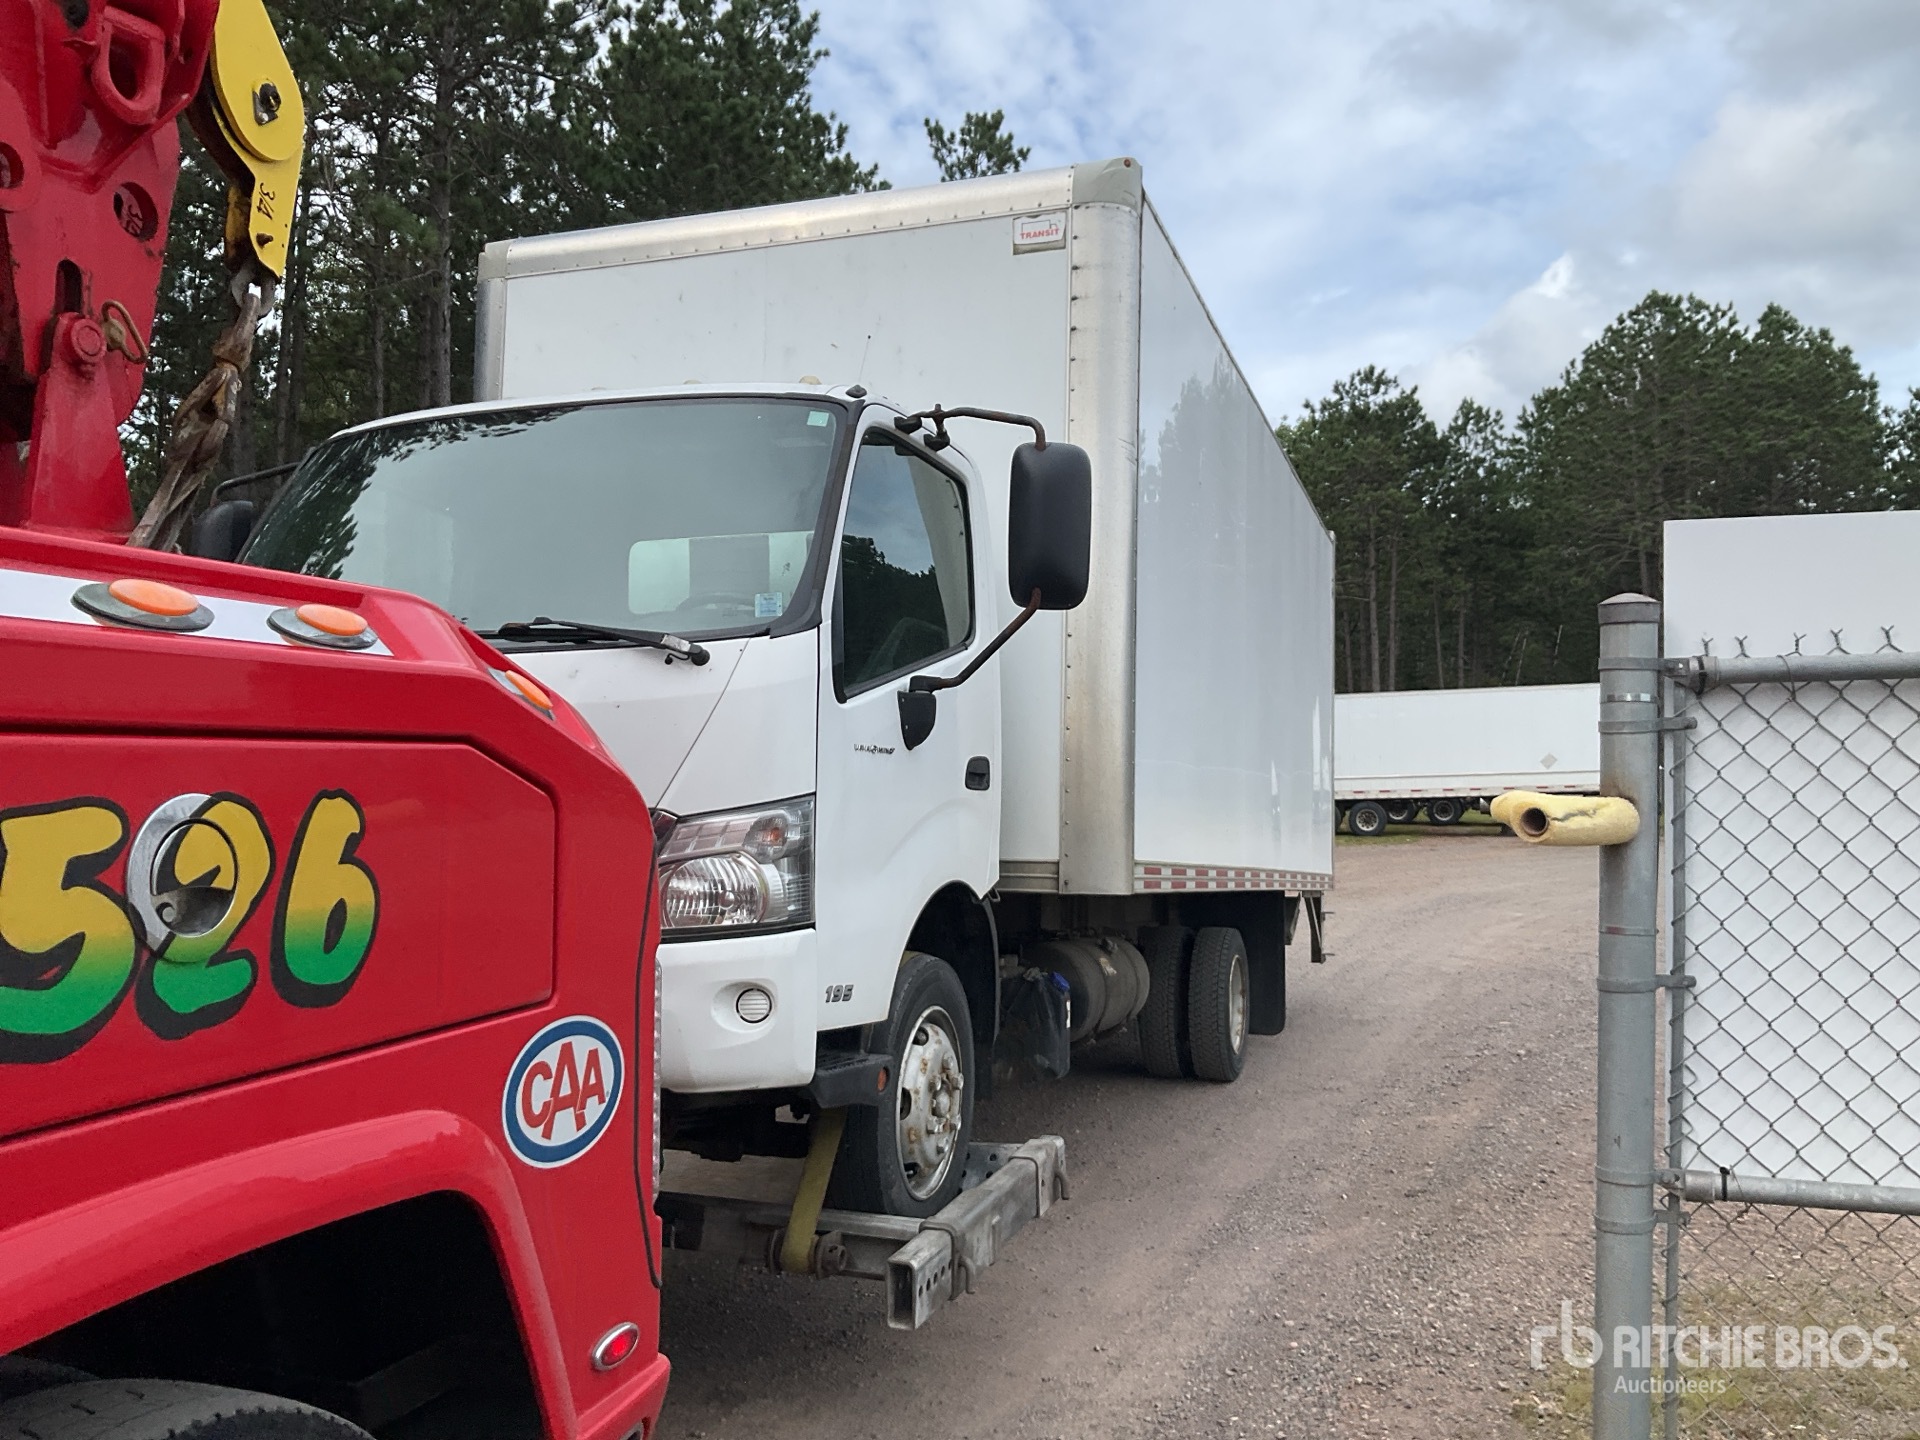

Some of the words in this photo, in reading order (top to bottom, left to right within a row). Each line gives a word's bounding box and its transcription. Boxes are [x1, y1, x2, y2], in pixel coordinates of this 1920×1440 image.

[257, 182, 276, 220] 3/4
[1020, 228, 1060, 240] TRANSIT
[0, 788, 380, 1064] 526
[825, 984, 854, 1003] 195
[521, 1040, 606, 1141] CAA
